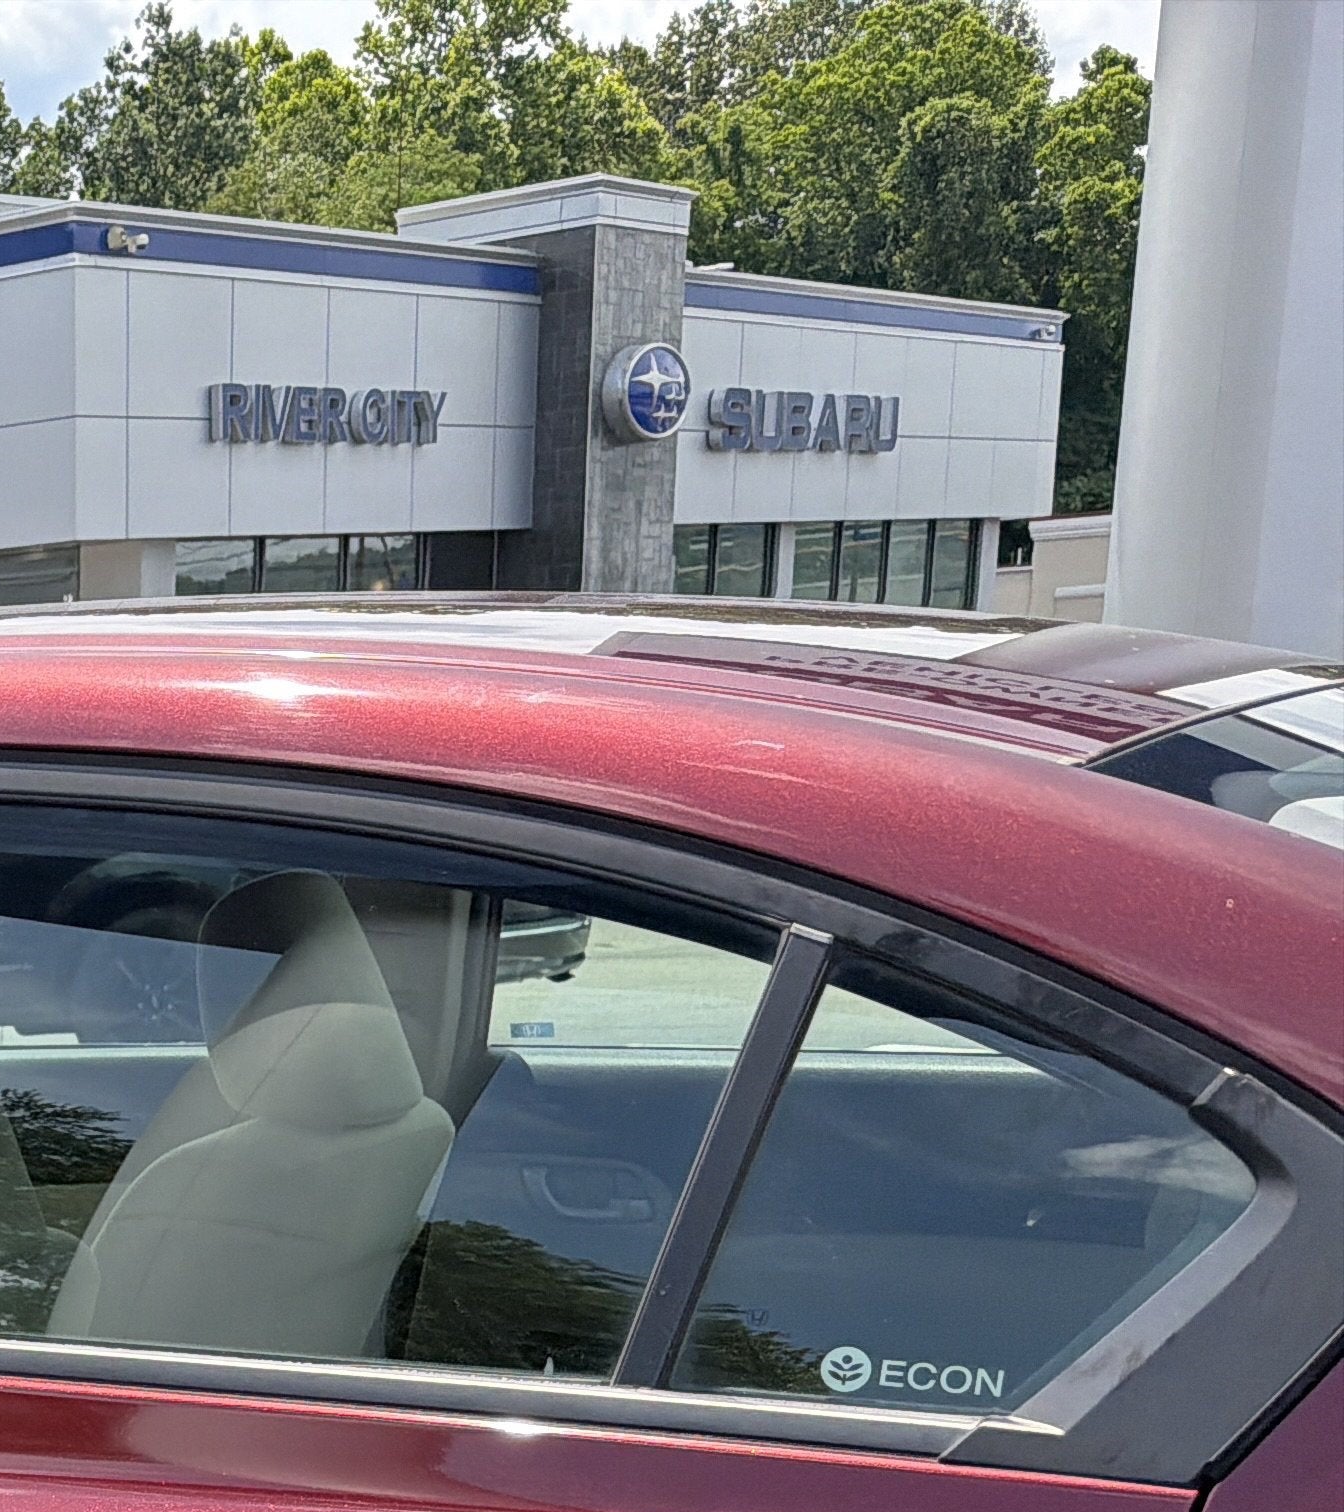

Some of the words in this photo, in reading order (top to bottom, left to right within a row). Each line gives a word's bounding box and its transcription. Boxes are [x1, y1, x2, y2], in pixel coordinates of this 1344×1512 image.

[210, 383, 348, 444] RIVER
[350, 388, 447, 446] CITY
[708, 387, 900, 452] SUBARU
[879, 1359, 1005, 1398] ECON
